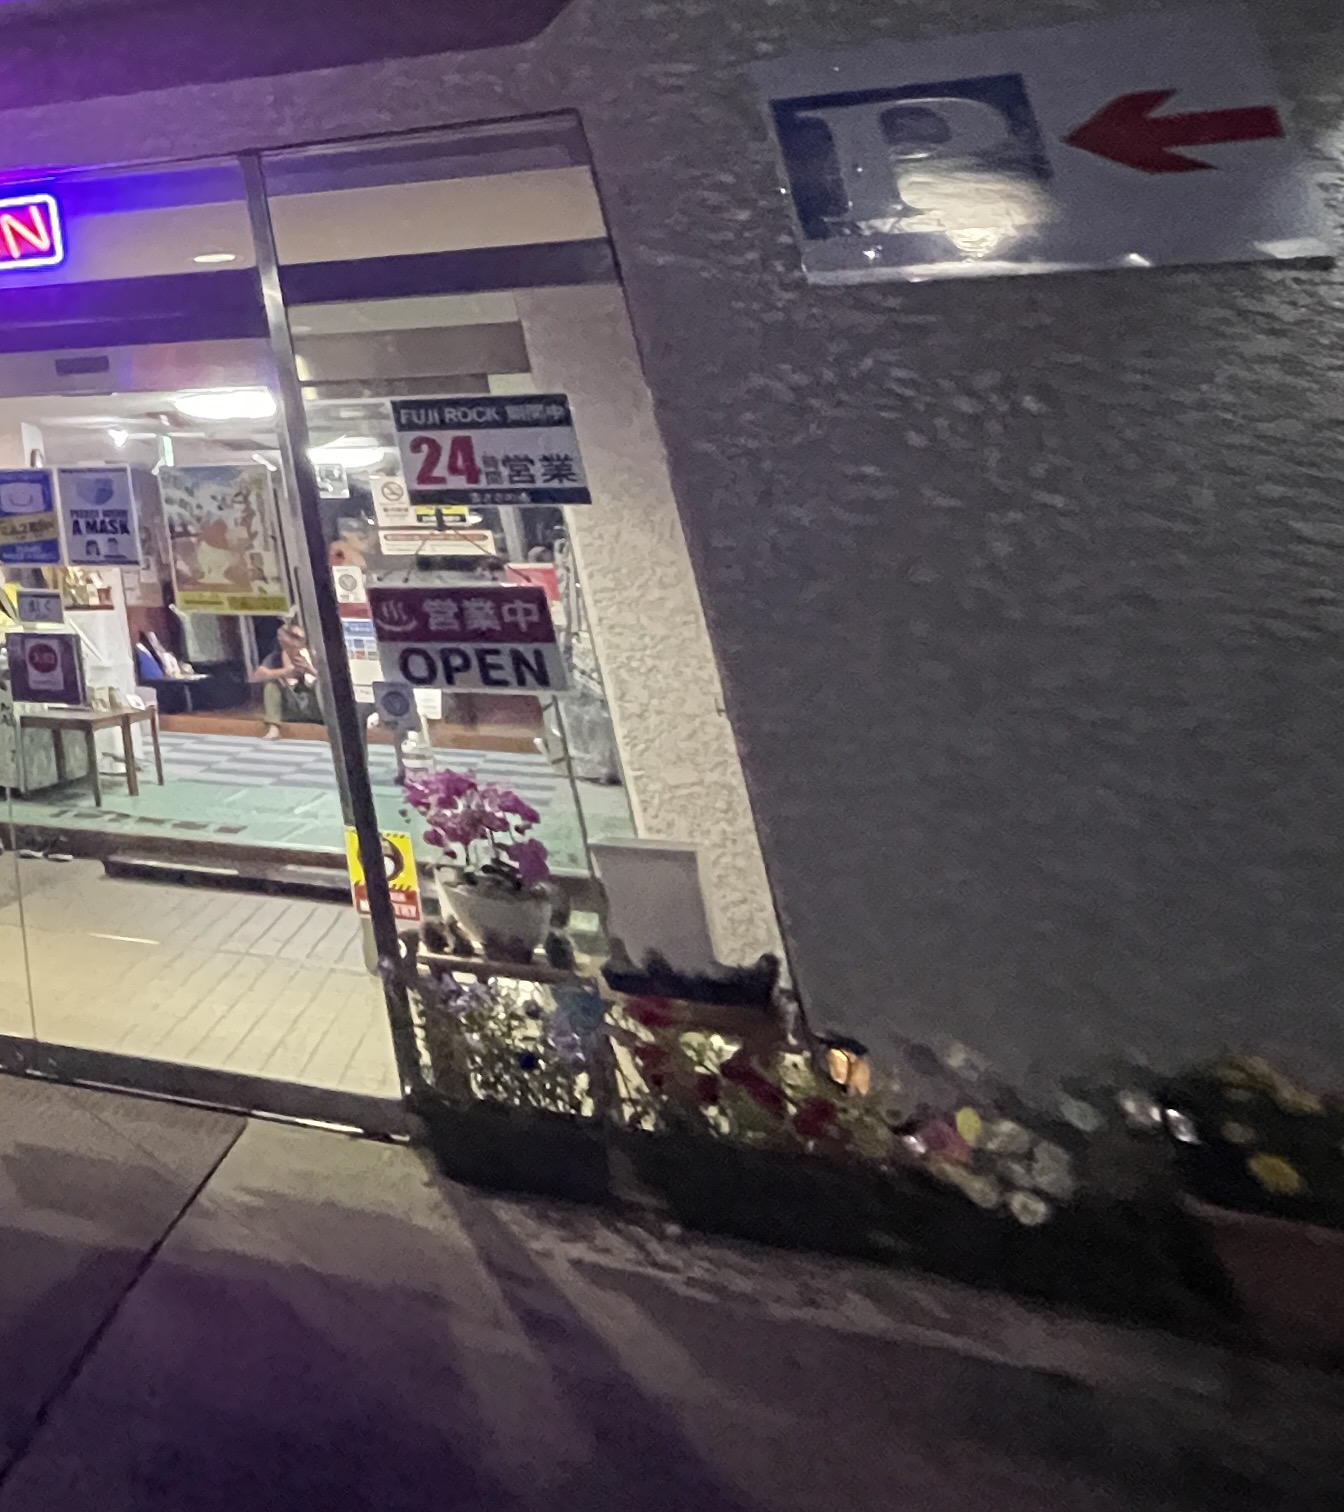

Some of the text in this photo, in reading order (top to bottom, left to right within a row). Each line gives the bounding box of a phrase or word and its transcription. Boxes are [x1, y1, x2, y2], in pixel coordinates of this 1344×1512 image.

[399, 408, 440, 426] FUJI
[444, 406, 501, 424] ROCK
[72, 519, 83, 536] A
[85, 519, 131, 535] MASK
[421, 597, 541, 633] 営業中
[398, 646, 552, 688] OPEN
